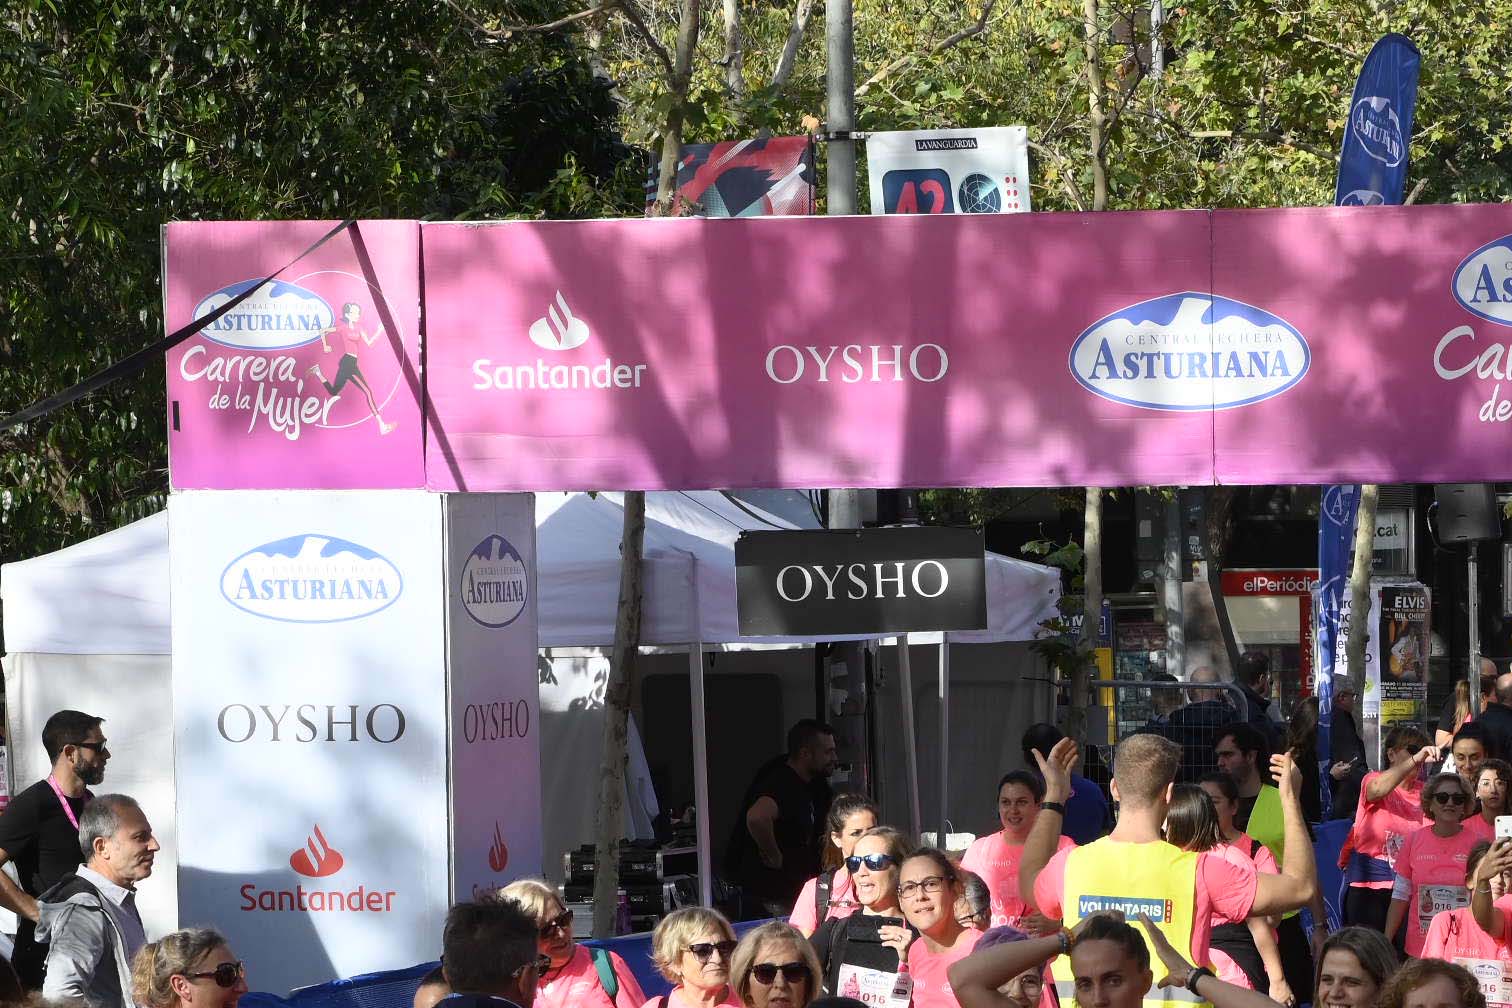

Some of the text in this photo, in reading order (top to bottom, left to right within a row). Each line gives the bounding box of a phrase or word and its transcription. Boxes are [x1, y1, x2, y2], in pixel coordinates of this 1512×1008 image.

[203, 304, 323, 332] ASTURIANA
[1125, 331, 1285, 345] CENTRAL LECHERA
[179, 344, 297, 382] Carrera
[472, 359, 647, 390] Santander
[765, 343, 950, 384] OYSHO
[1086, 337, 1293, 381] ASTURIANA
[208, 378, 342, 441] de la Mujer
[233, 567, 389, 600] ASTURIANA
[465, 569, 524, 605] ASTURIANA
[776, 560, 949, 603] OYSHO
[1394, 596, 1425, 609] ELVIS
[217, 703, 406, 744] OYSHO
[463, 699, 530, 744] OYSHO
[239, 884, 396, 912] Santander
[863, 993, 886, 1004] 016
